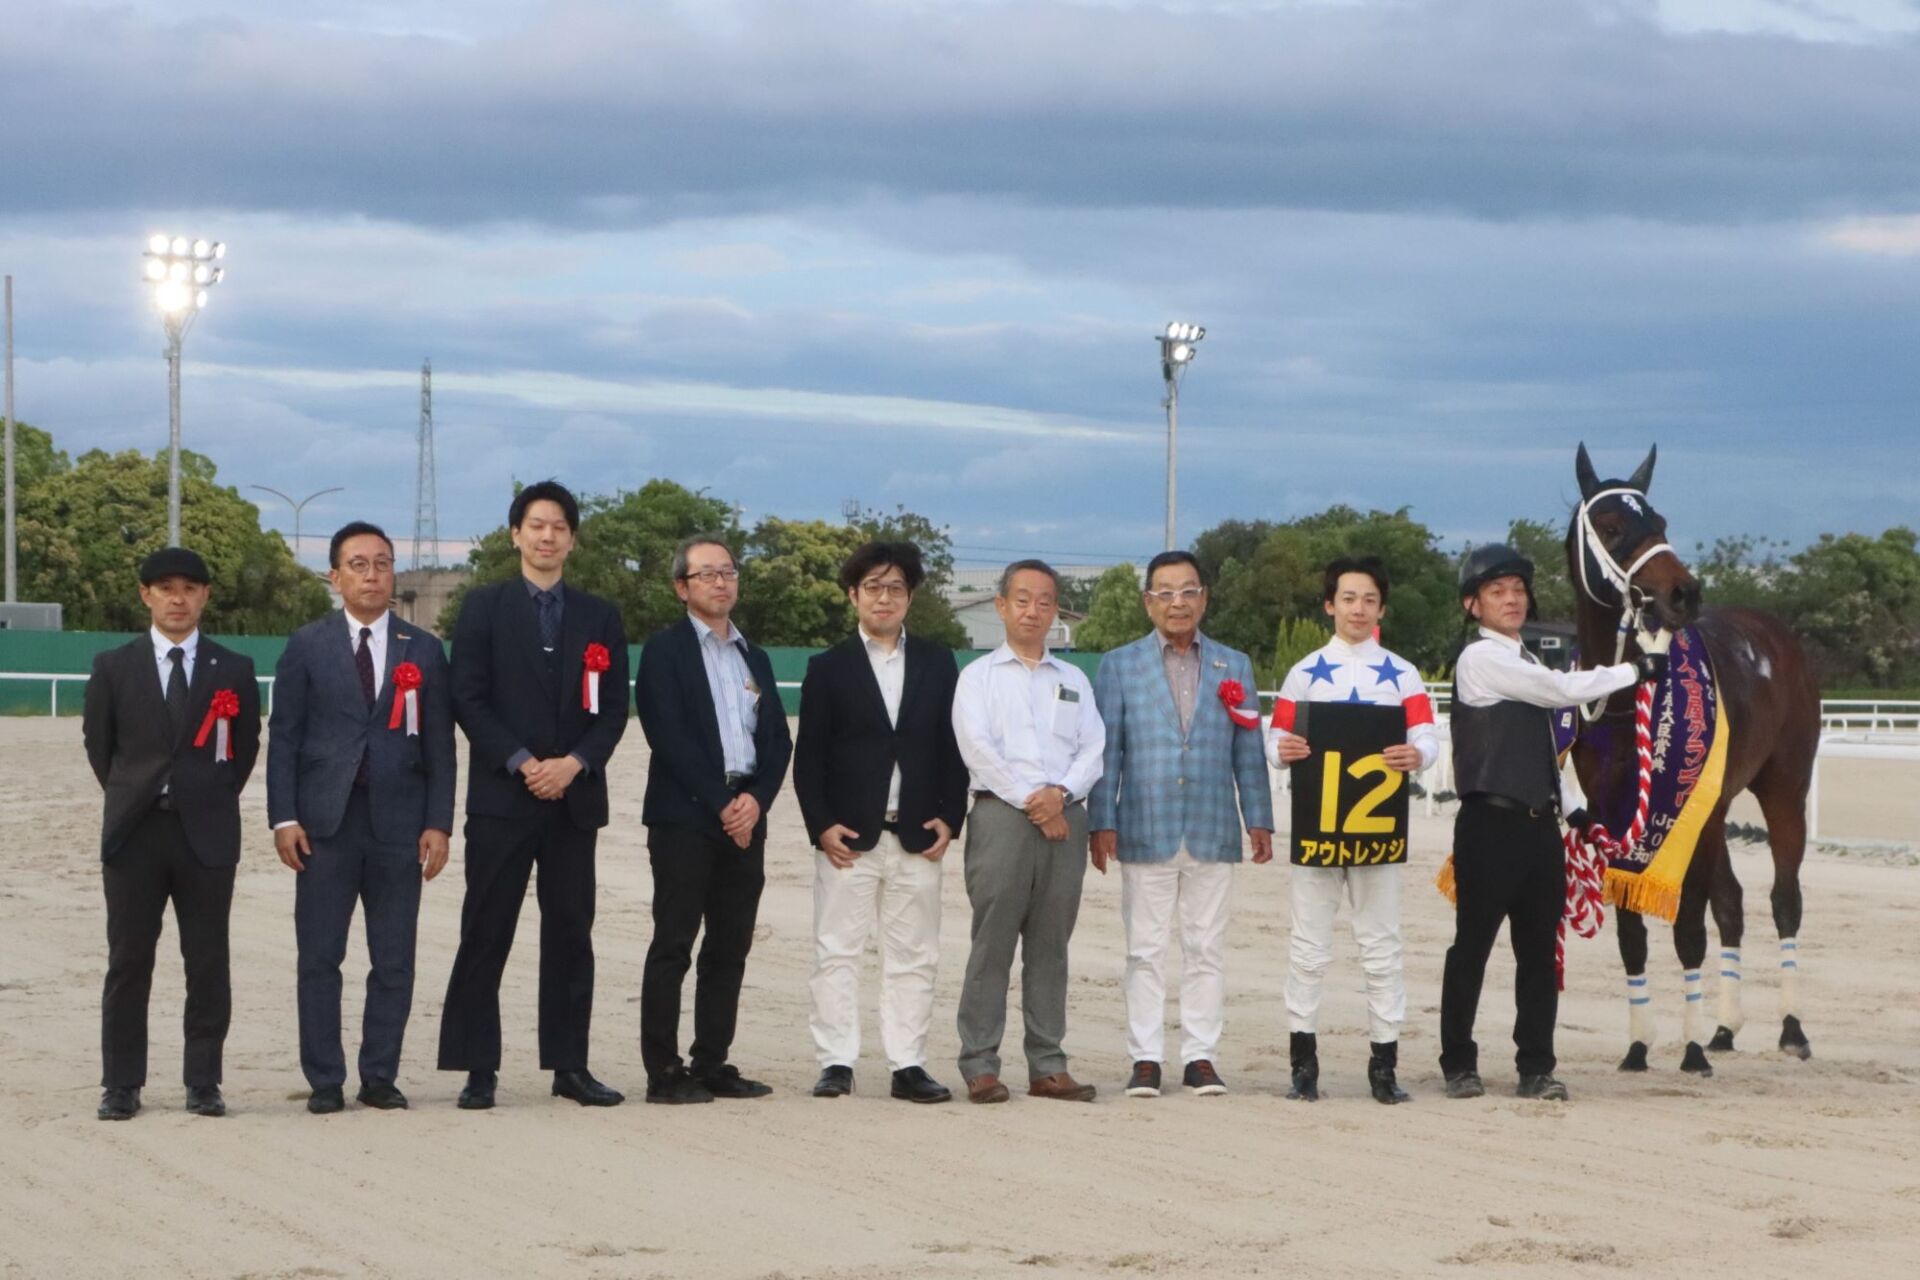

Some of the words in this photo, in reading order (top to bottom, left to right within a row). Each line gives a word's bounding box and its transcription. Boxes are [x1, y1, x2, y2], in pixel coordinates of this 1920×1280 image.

[1320, 751, 1403, 833] 12
[1301, 838, 1404, 866] アウトレンジ
